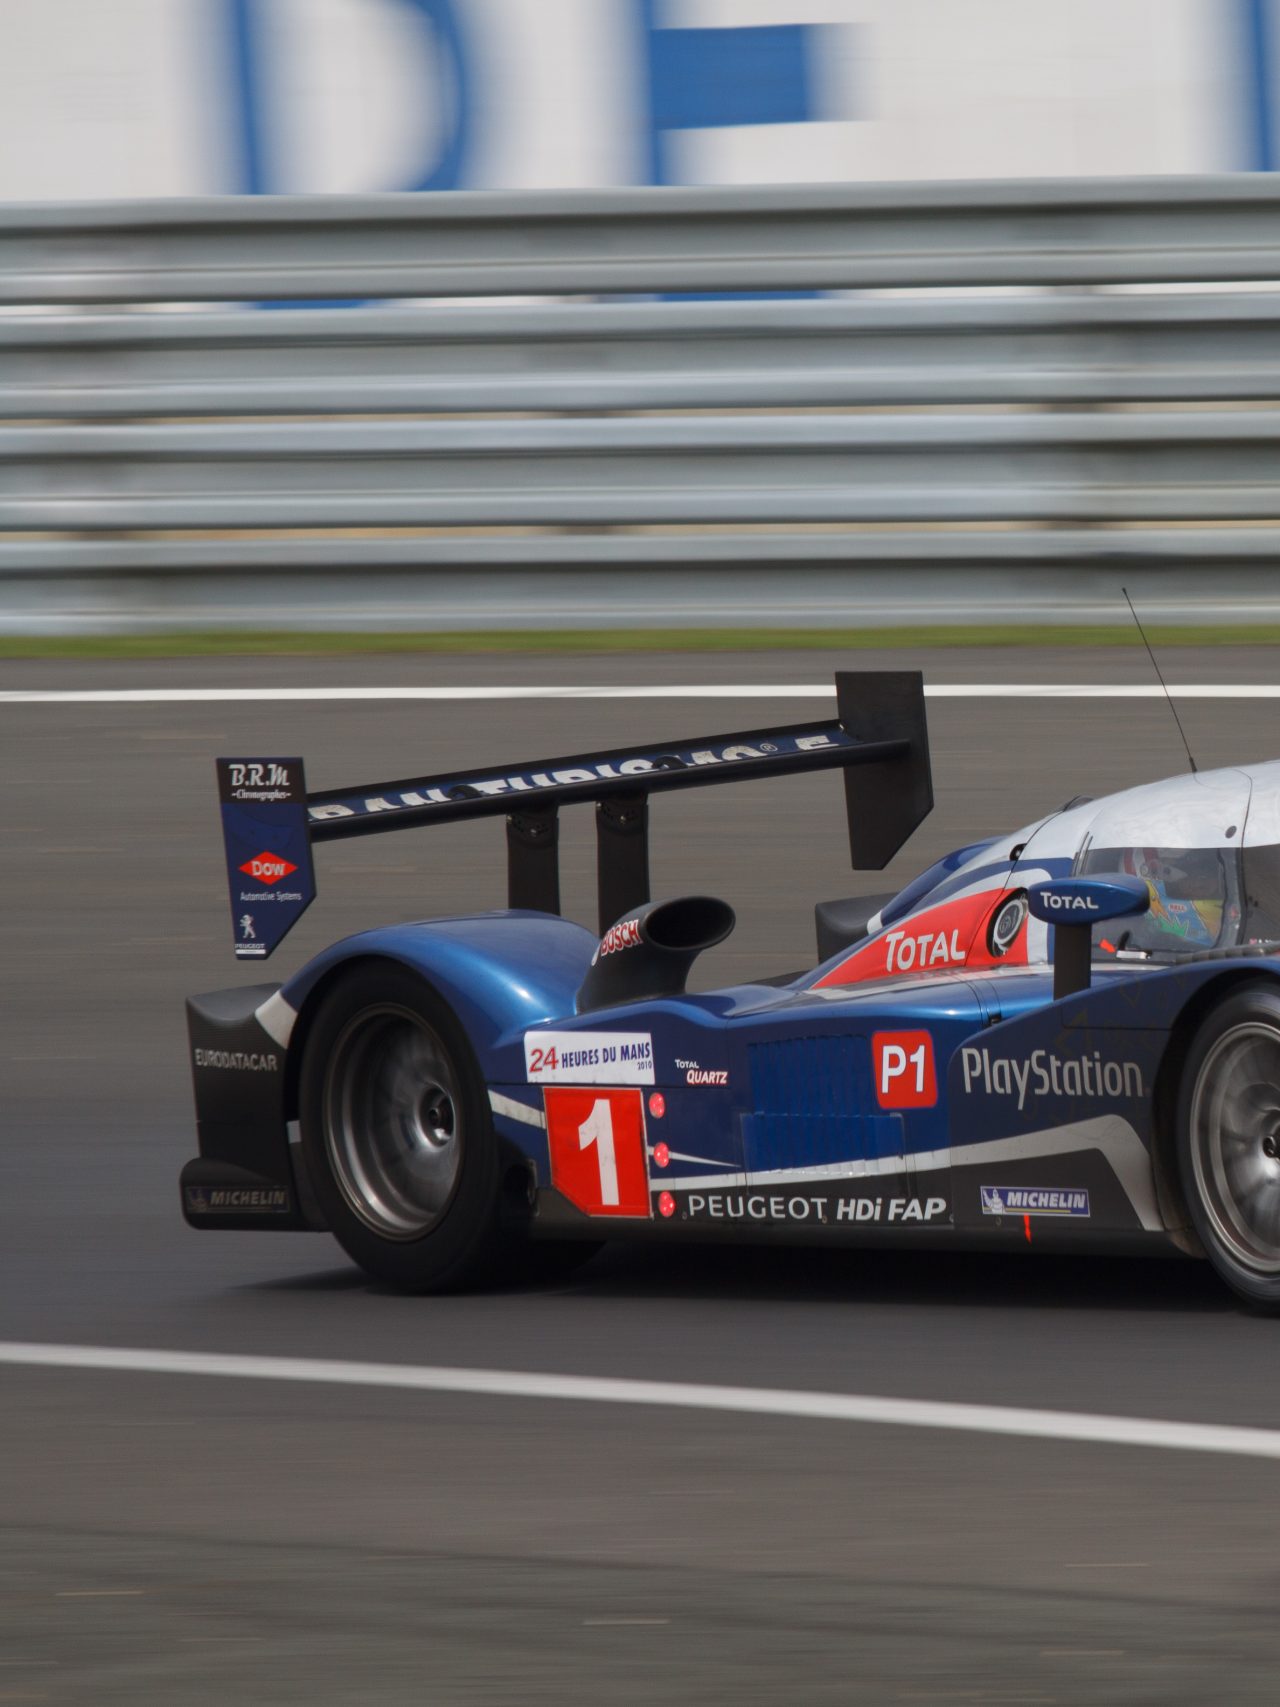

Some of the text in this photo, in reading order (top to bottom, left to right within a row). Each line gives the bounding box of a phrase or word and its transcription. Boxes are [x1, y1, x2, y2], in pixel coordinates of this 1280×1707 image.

[240, 891, 302, 902] Automotive Systems
[1040, 891, 1099, 910] TOTAL
[601, 919, 643, 957] BOSCH
[885, 929, 966, 972] TOTAL
[194, 1048, 278, 1071] EURODATACAR
[529, 1042, 650, 1072] 24 HEURES DU MANS
[637, 1060, 652, 1070] 2010
[675, 1058, 699, 1069] TOTAL
[686, 1070, 728, 1084] QUARTZ
[882, 1045, 925, 1093] P1
[962, 1048, 1144, 1110] PlayStation
[578, 1098, 619, 1206] 1
[209, 1190, 286, 1206] MICHELIN
[688, 1195, 946, 1221] PEUGEOT HDi FAP
[1006, 1190, 1087, 1208] MICHELIN
